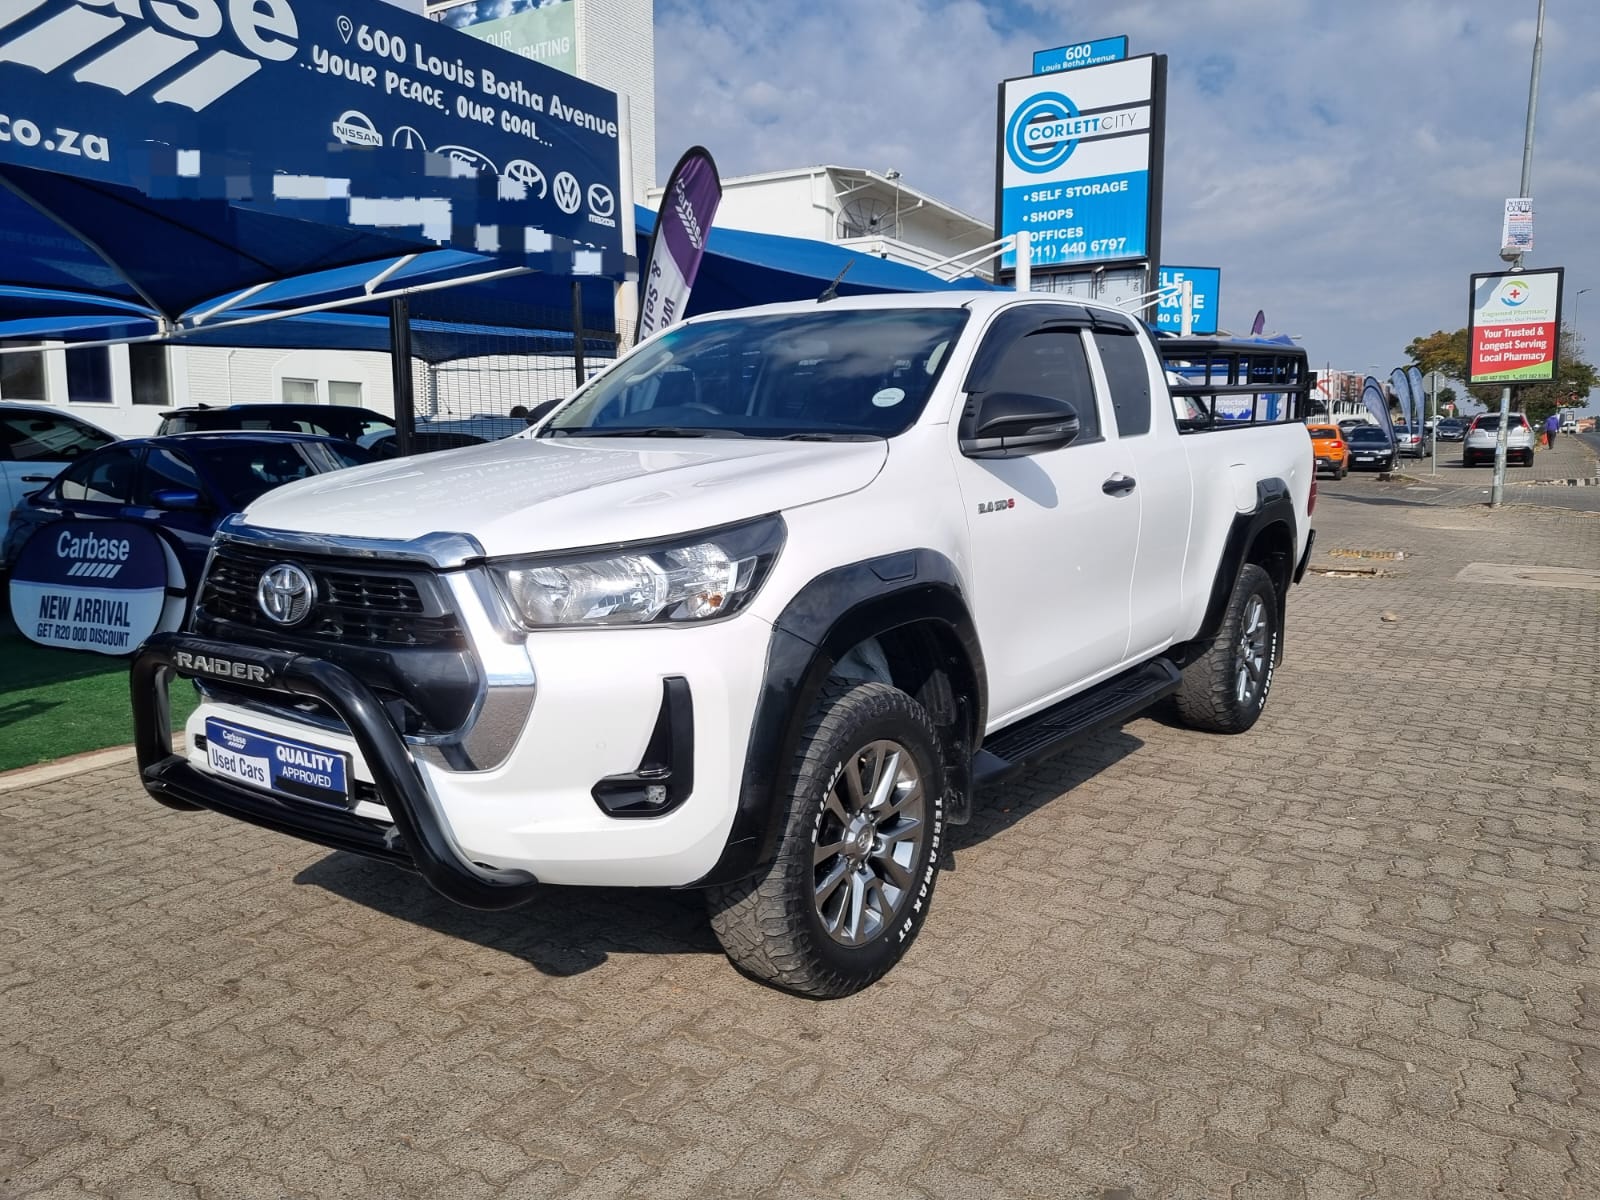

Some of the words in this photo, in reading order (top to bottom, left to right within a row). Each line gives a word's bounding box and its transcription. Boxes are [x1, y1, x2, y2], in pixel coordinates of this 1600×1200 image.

[1065, 44, 1091, 60] 600
[1041, 63, 1061, 73] Louis
[1062, 59, 1085, 69] Botha
[1086, 54, 1116, 65] Avenue
[357, 24, 407, 63] 600
[415, 43, 475, 88] Louis
[481, 68, 544, 112] Botha
[549, 95, 617, 138] Avenue
[456, 95, 496, 127] OUR
[336, 125, 380, 146] NISSAN
[1030, 188, 1062, 203] SELF
[1065, 180, 1129, 198] STORAGE
[1030, 208, 1074, 223] SHOPS
[1030, 226, 1084, 242] OFFICES
[1060, 241, 1087, 254] 440
[1090, 237, 1127, 252] 6797
[651, 260, 662, 279] &
[643, 284, 658, 333] Sell
[1483, 329, 1502, 339] Your
[1504, 327, 1536, 337] Trusted
[1536, 326, 1544, 336] &
[1479, 341, 1513, 351] Longest
[1514, 339, 1547, 350] Serving
[1479, 352, 1502, 363] Local
[1503, 352, 1546, 362] Pharmacy
[57, 530, 130, 560] Carbase
[39, 595, 71, 620] NEW
[73, 597, 131, 627] ARRIVAL
[37, 622, 53, 638] GET
[54, 624, 71, 640] R20
[72, 626, 87, 642] 000
[89, 628, 130, 647] DISCOUNT
[177, 651, 265, 682] RAIDER
[222, 730, 247, 745] Carbase
[211, 748, 237, 773] Used
[239, 757, 265, 782] Cars
[276, 745, 334, 773] QUALITY
[282, 765, 332, 788] APPROVED
